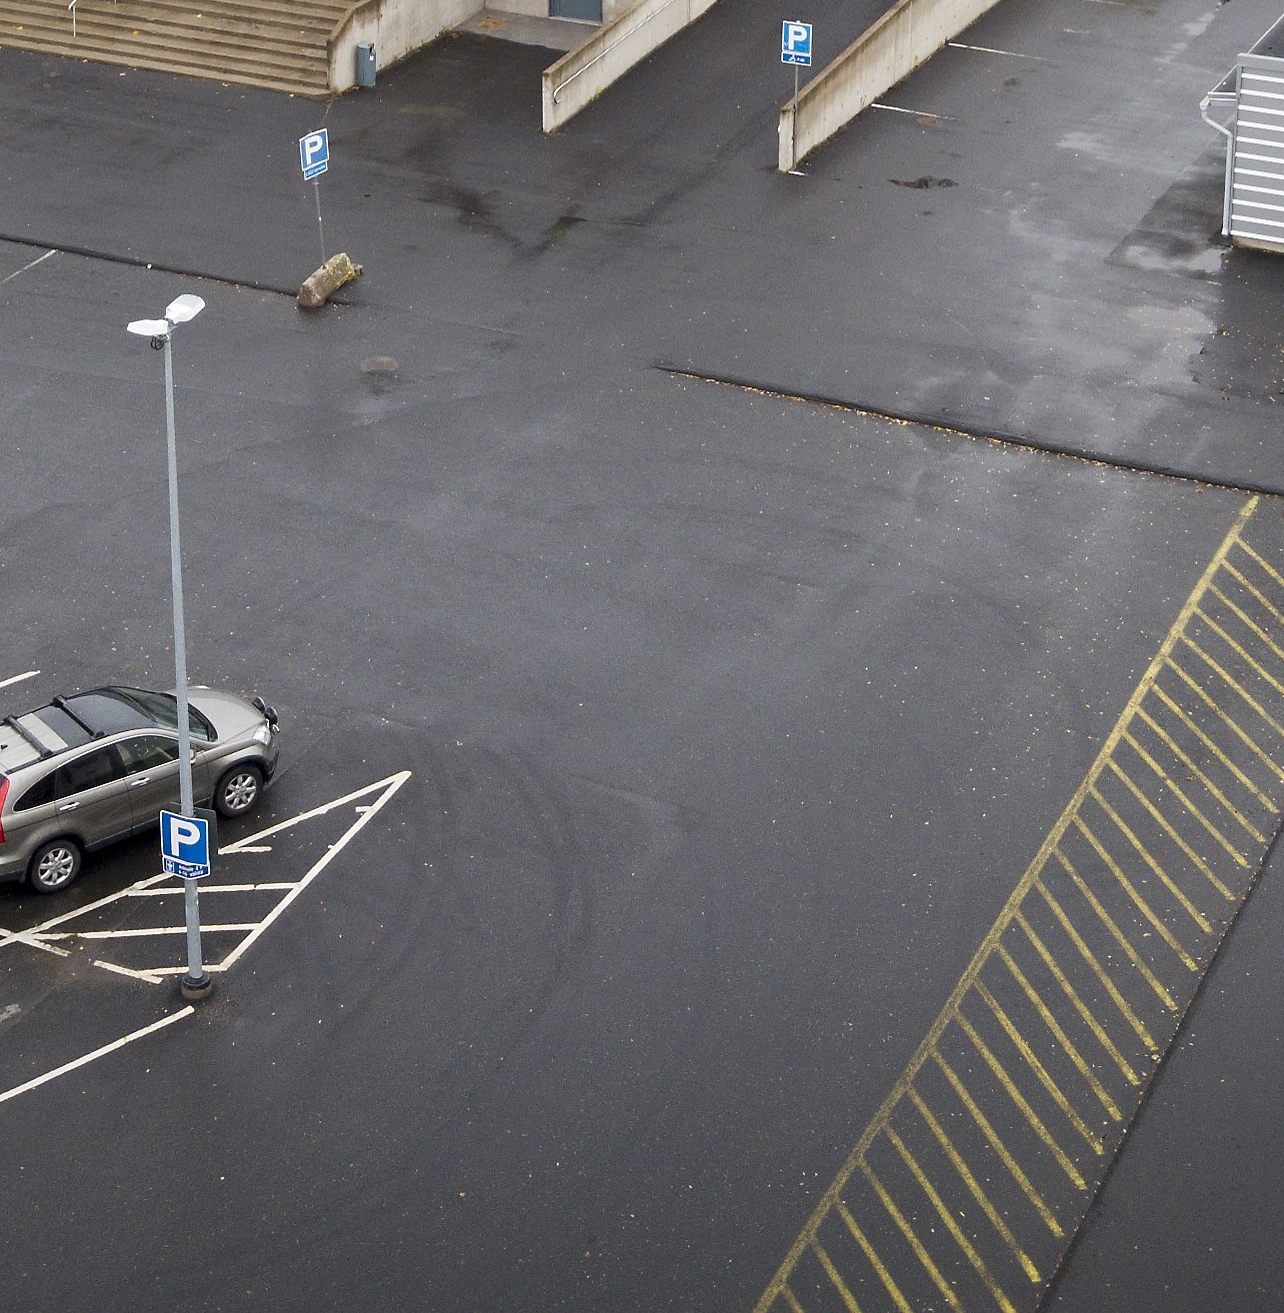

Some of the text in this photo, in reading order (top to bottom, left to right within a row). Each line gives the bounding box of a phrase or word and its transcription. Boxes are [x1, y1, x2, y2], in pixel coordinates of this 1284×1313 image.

[788, 25, 807, 50] P
[304, 134, 323, 165] P
[170, 816, 201, 857] P
